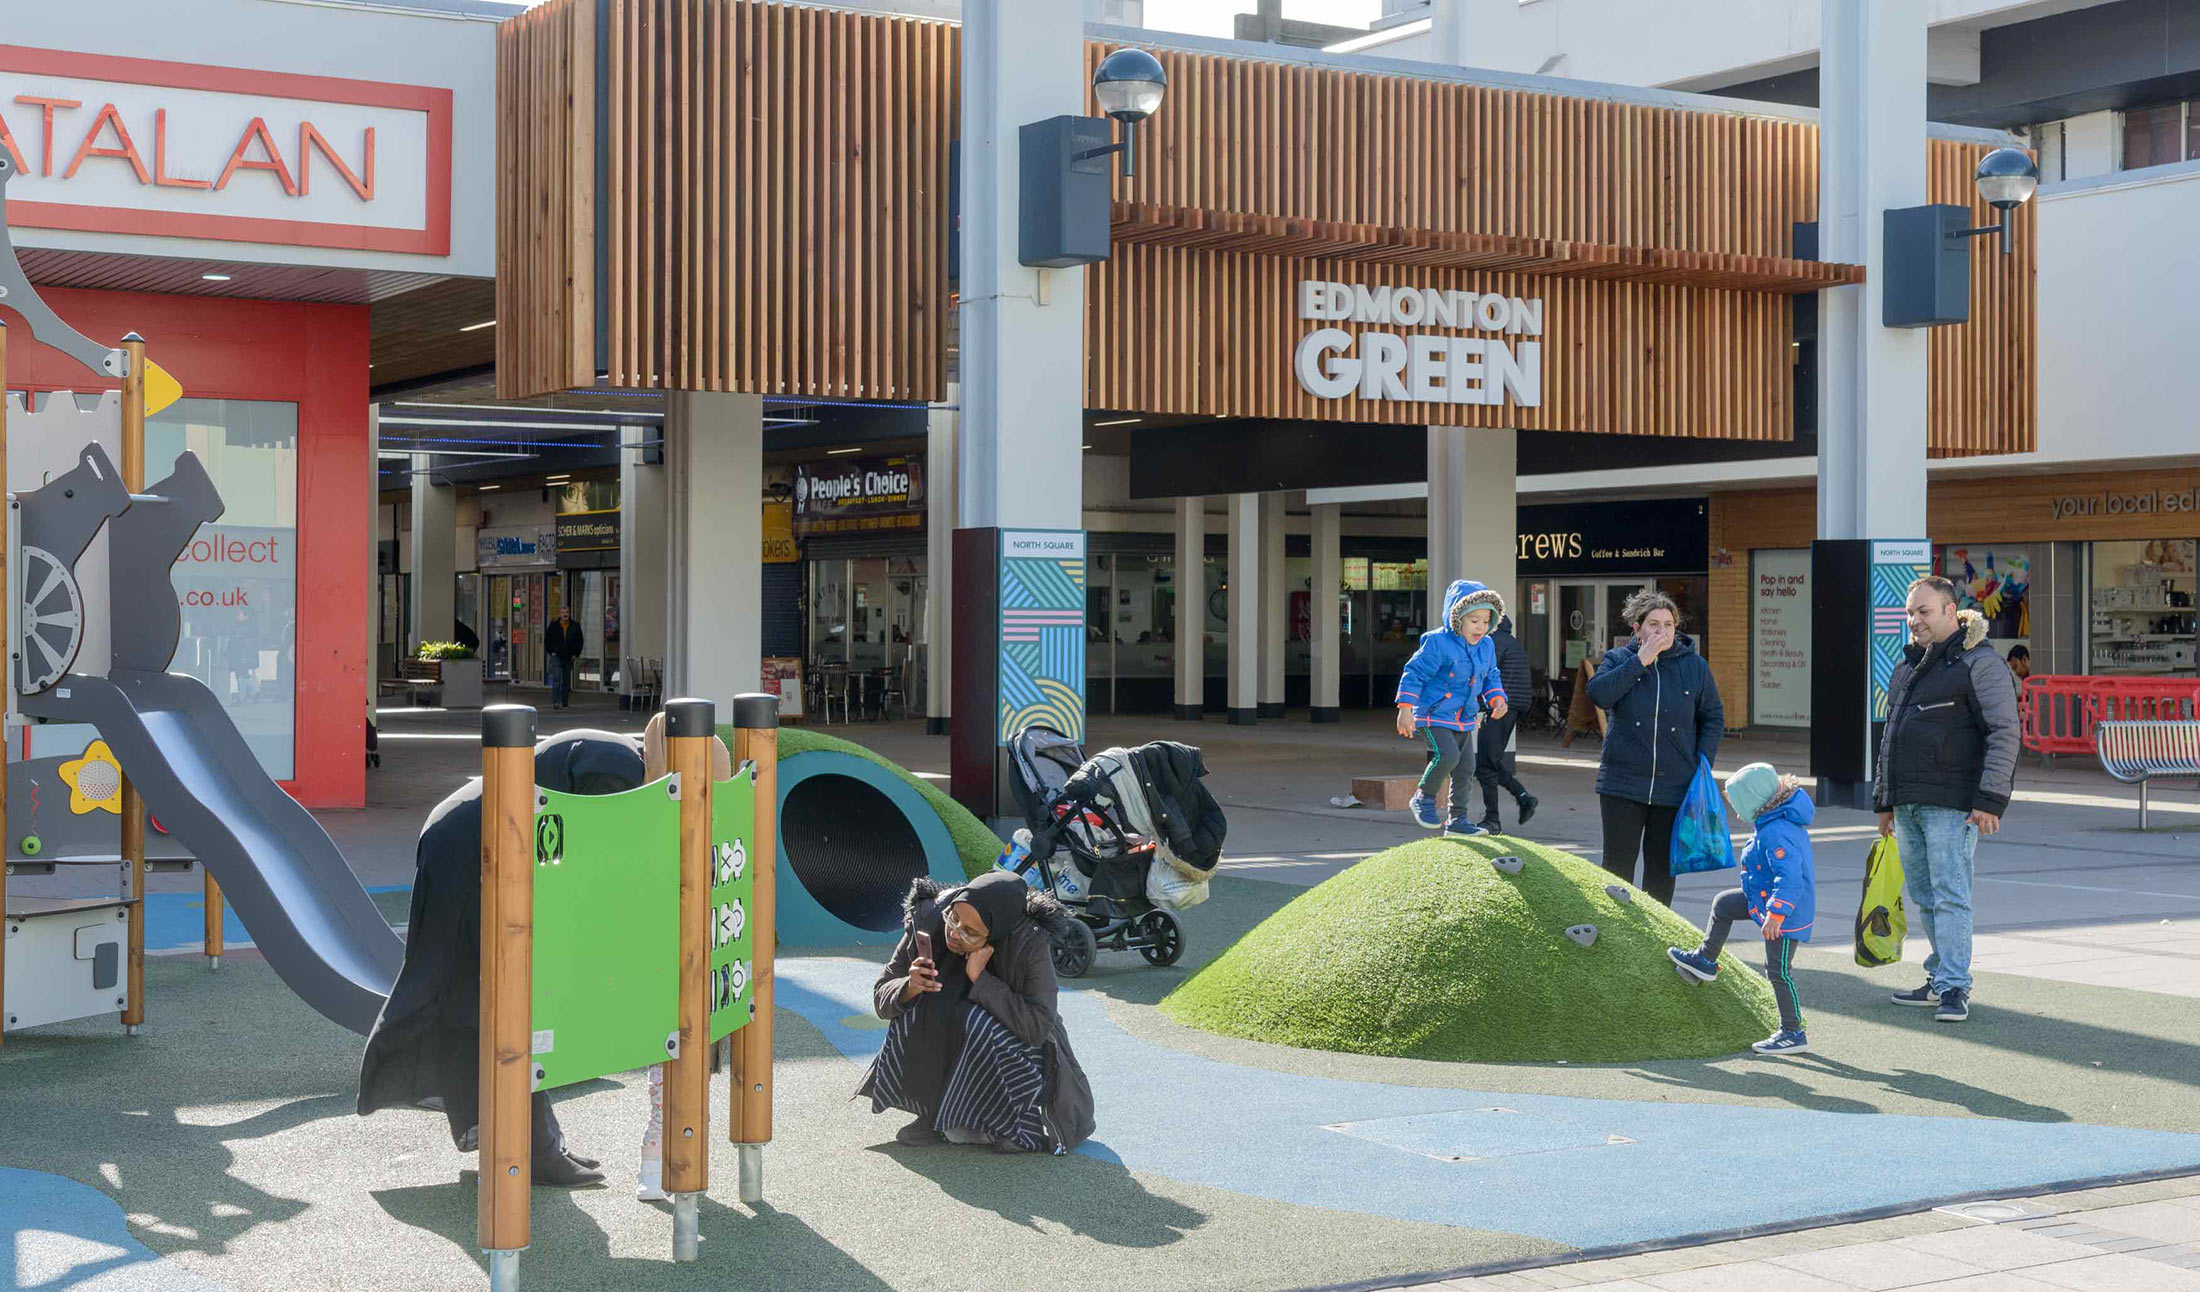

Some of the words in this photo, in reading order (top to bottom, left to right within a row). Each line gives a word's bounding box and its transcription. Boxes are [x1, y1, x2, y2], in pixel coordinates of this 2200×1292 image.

[1299, 280, 1542, 336] EDMONTON
[1295, 328, 1541, 407] GREEN
[811, 473, 861, 502] People's
[865, 471, 908, 496] Choice
[2052, 496, 2098, 521] your
[2103, 489, 2159, 514] local
[1013, 541, 1041, 549] NORTH
[1043, 541, 1074, 550] SQUARE
[1515, 532, 1582, 559] rews
[1591, 549, 1613, 559] Coffee
[1614, 549, 1620, 558] &
[1621, 547, 1651, 558] Sandwich
[1653, 548, 1666, 557] Bar
[1760, 574, 1776, 586] Pop
[1778, 574, 1786, 585] in
[1787, 574, 1804, 585] and
[180, 587, 248, 607] .co.uk
[1760, 589, 1775, 598] say
[1776, 587, 1797, 597] hello
